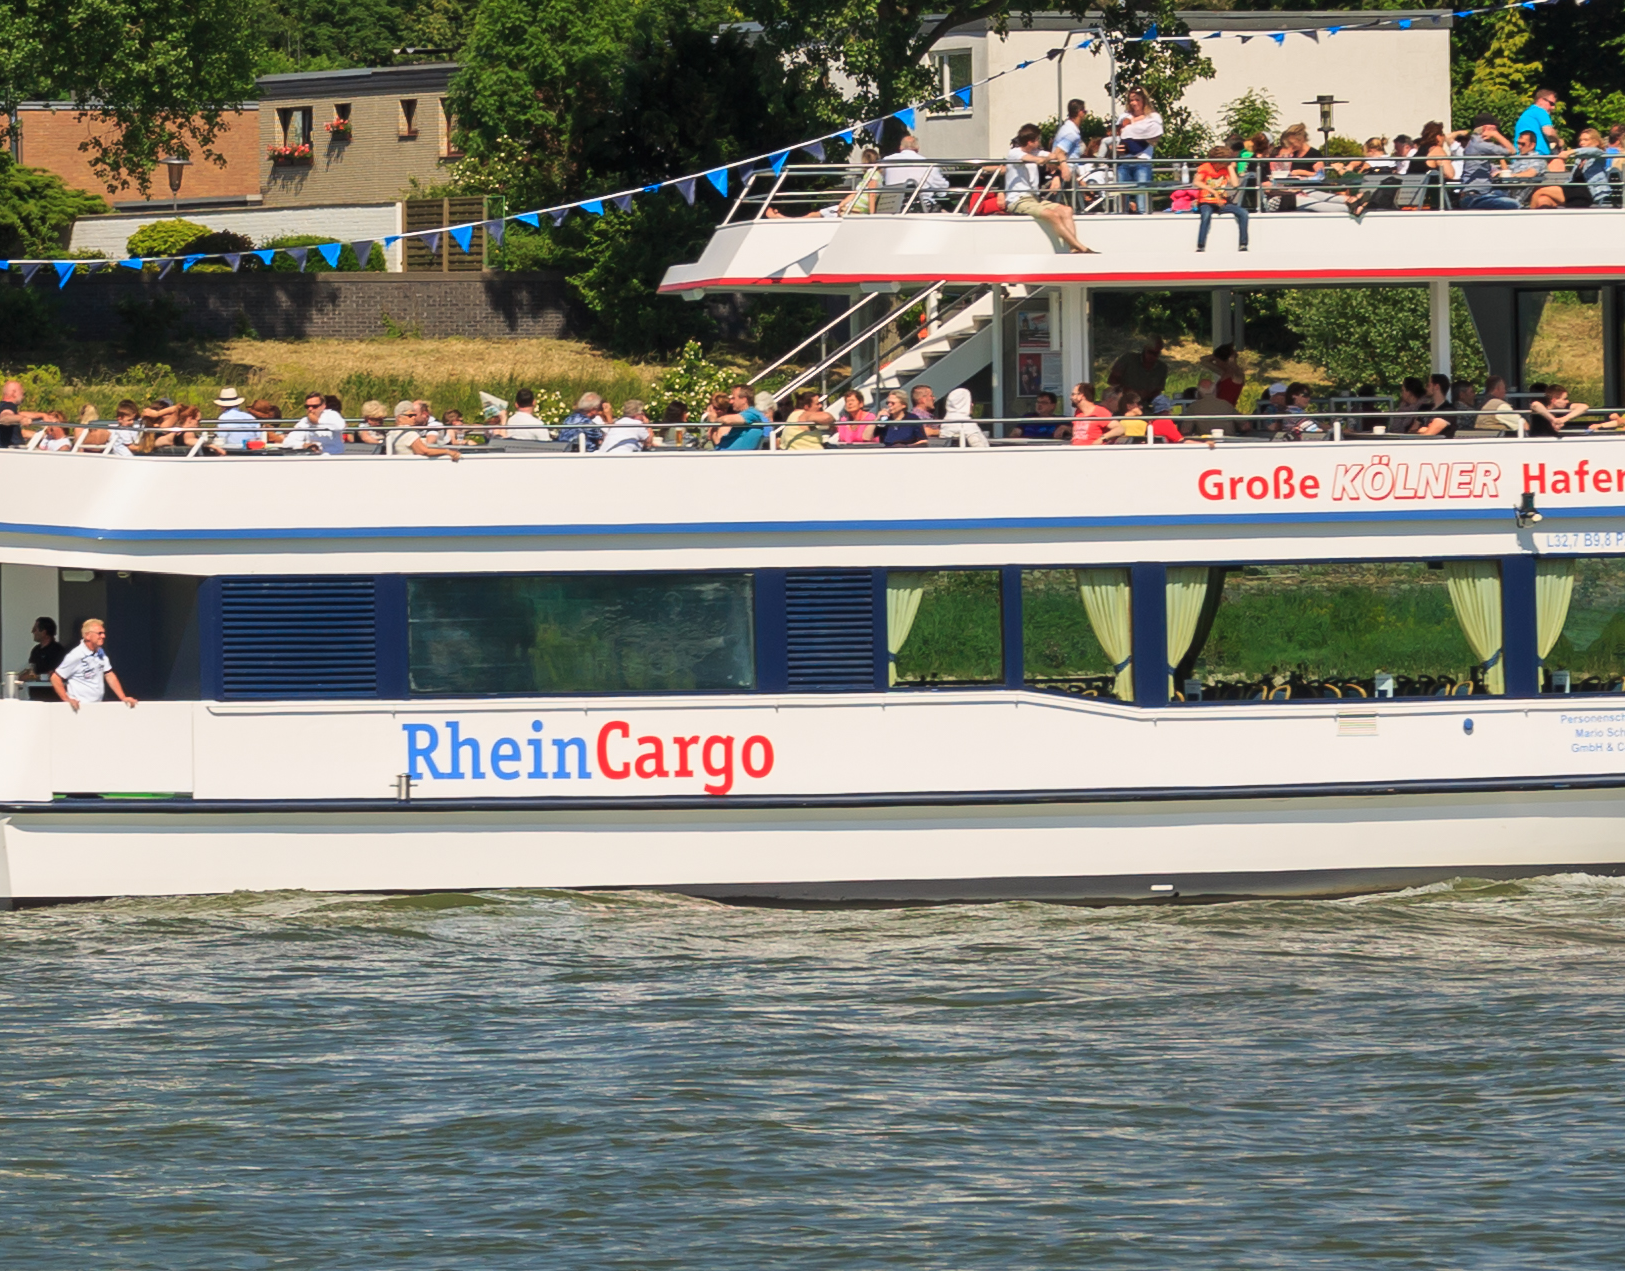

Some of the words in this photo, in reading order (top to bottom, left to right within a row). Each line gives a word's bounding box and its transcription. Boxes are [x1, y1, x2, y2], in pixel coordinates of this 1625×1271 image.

[1198, 465, 1320, 501] Große
[1331, 455, 1502, 501] KÖLNER
[1546, 534, 1579, 549] L32,7
[1584, 533, 1611, 548] B9,8
[1575, 728, 1603, 738] Mario
[1571, 743, 1603, 752] GmbH
[1606, 743, 1613, 751] &
[402, 720, 775, 796] RheinCargo
